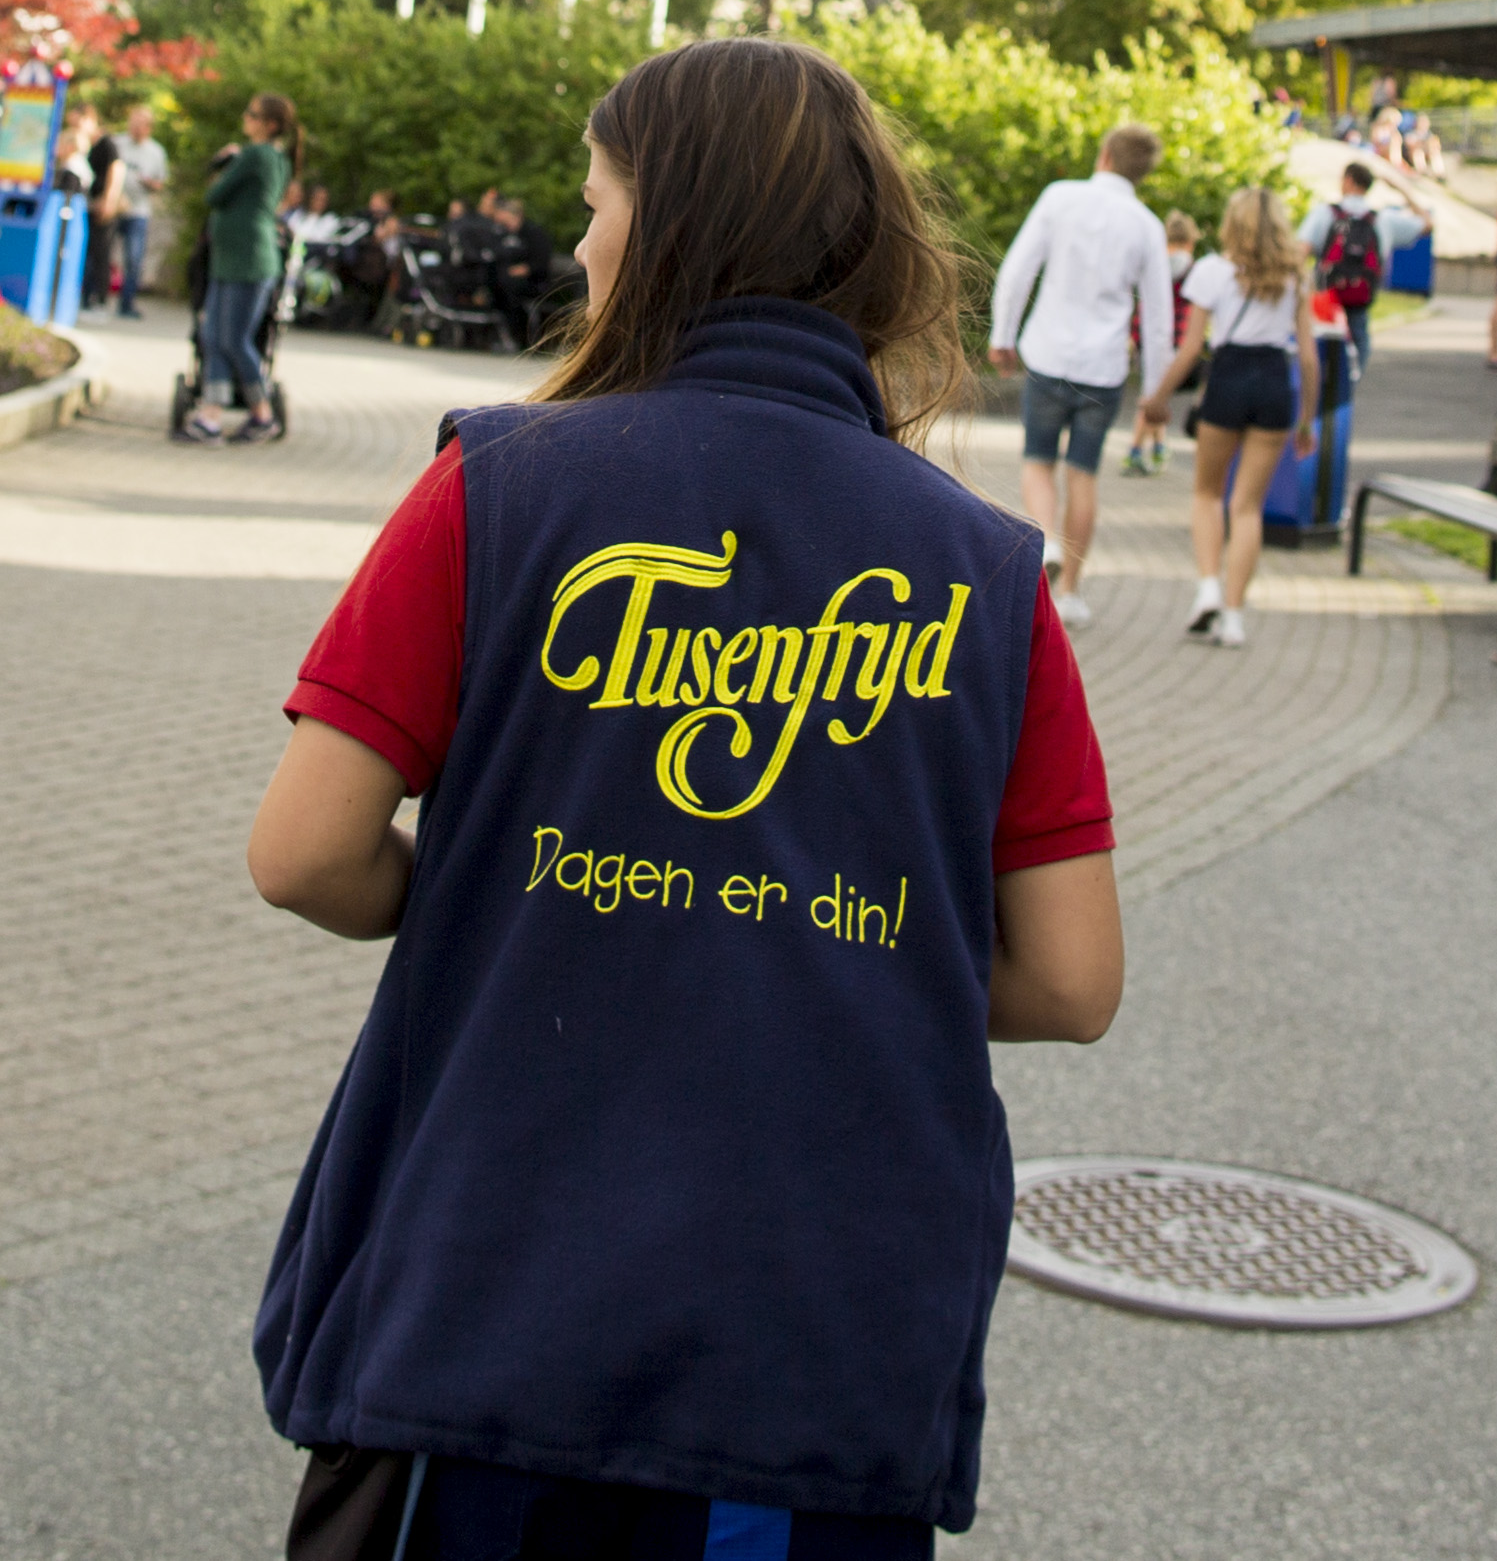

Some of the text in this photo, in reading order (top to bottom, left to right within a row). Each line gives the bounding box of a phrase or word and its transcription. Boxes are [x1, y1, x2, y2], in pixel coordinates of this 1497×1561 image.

[542, 531, 971, 820] Tusenfryd
[526, 826, 907, 949] Dagen er din!
